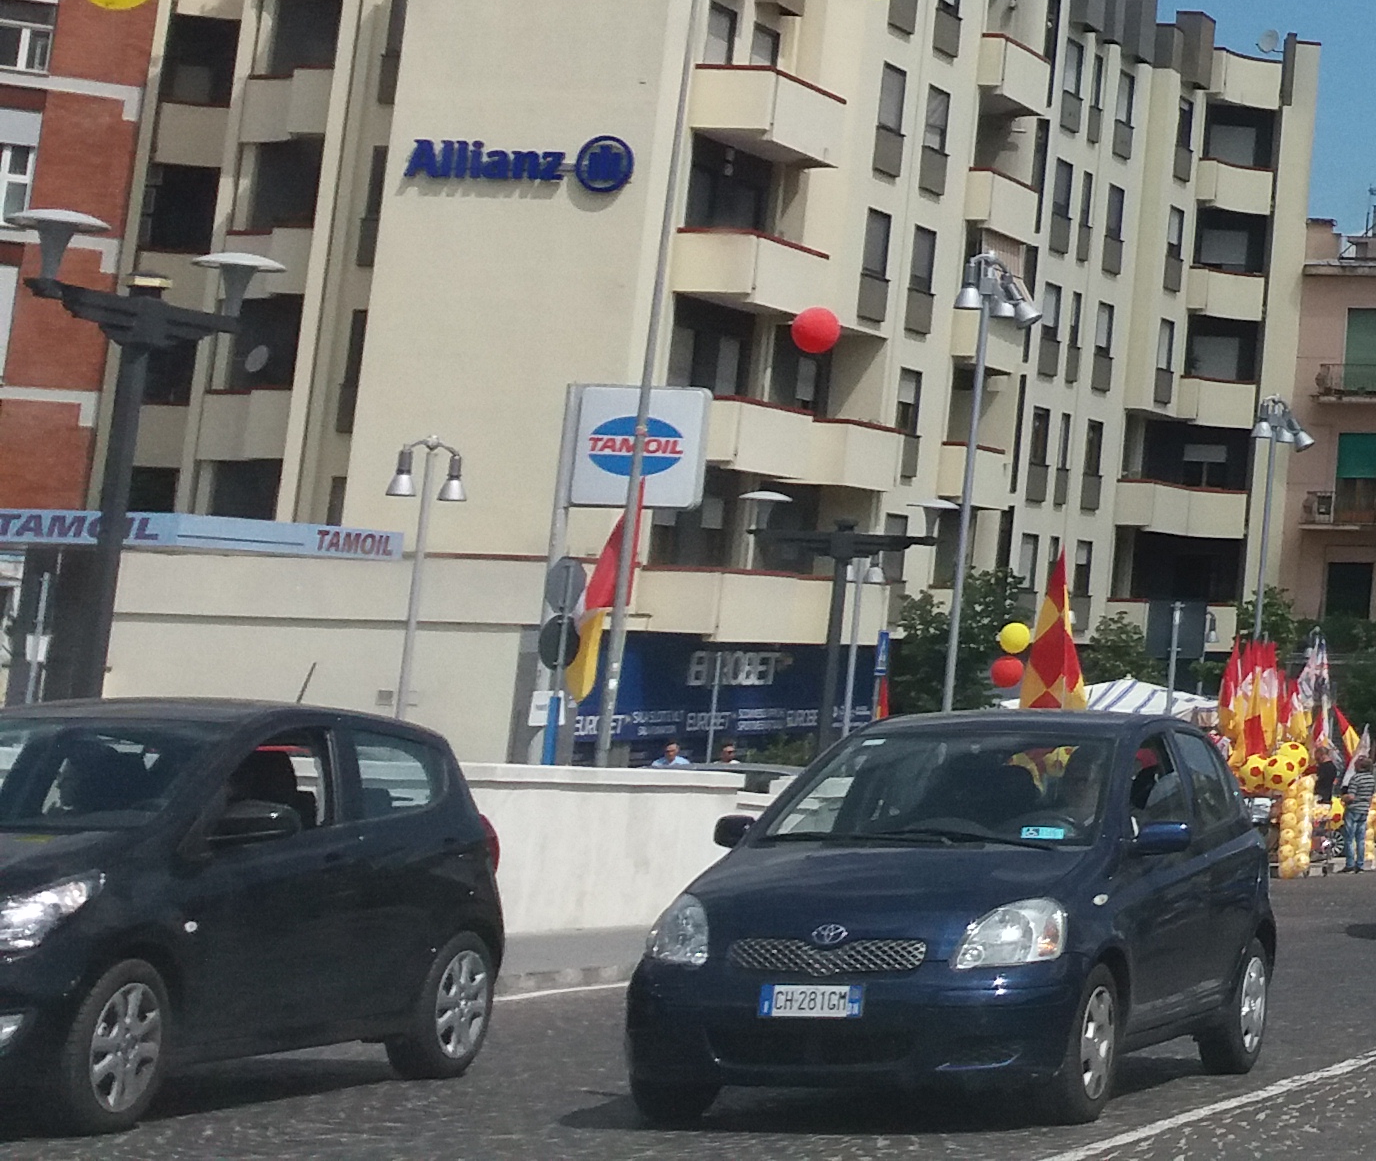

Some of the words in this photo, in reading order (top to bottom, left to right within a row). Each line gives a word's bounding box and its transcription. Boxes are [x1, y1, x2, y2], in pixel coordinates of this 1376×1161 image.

[404, 139, 566, 180] Allianz
[588, 437, 684, 454] TAMOIL
[317, 529, 393, 556] TAMOIL
